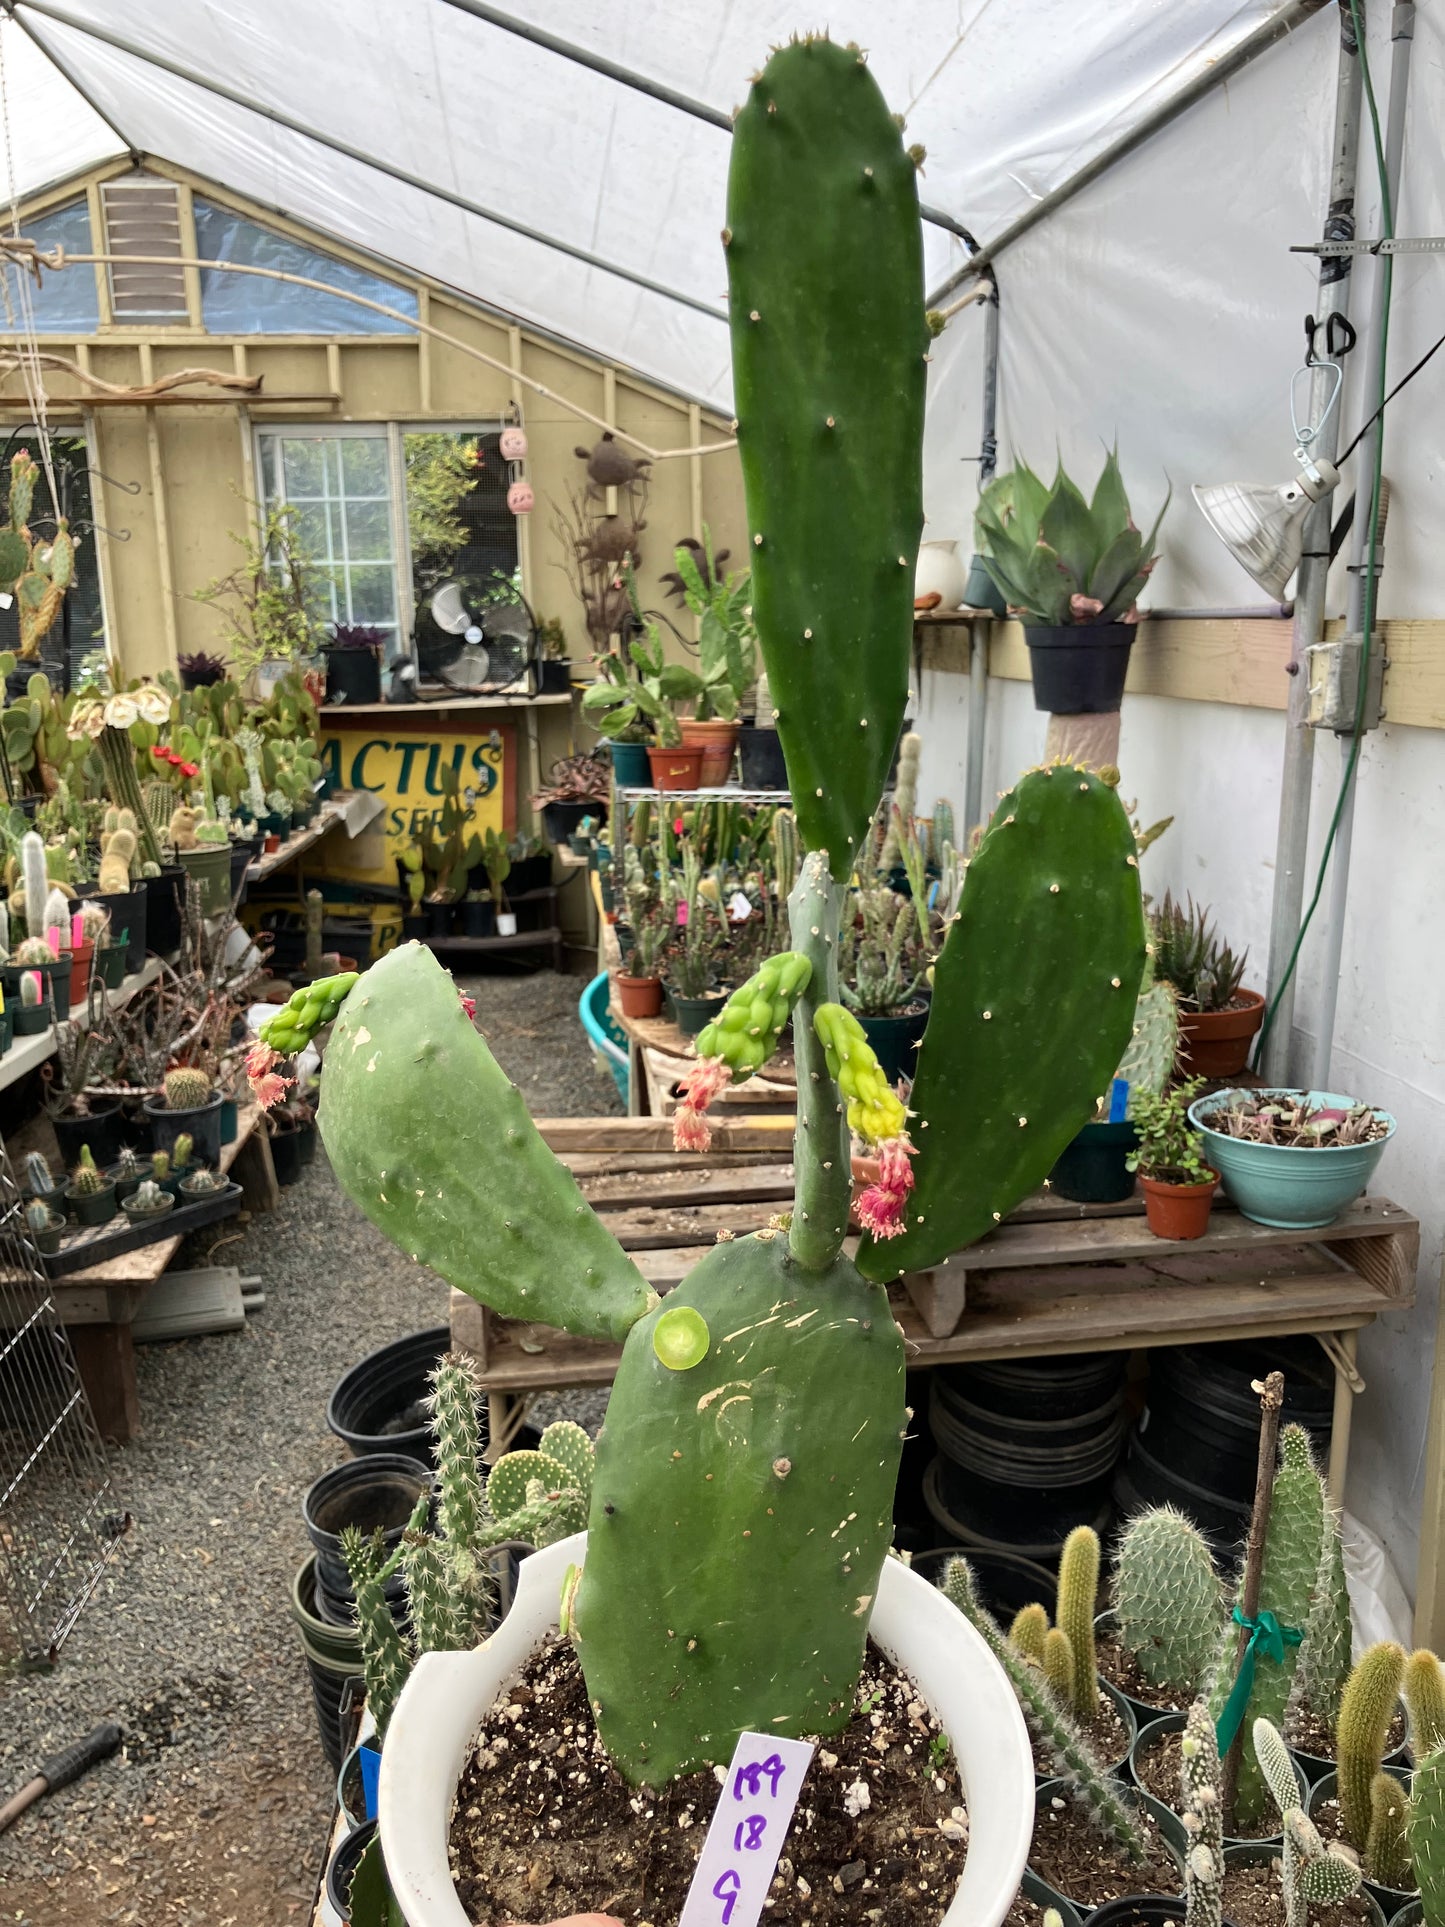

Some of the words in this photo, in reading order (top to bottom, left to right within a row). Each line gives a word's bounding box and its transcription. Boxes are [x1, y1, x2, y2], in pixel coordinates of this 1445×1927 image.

[733, 1753, 786, 1801] 189
[733, 1814, 767, 1852] 18
[712, 1869, 741, 1925] 9
